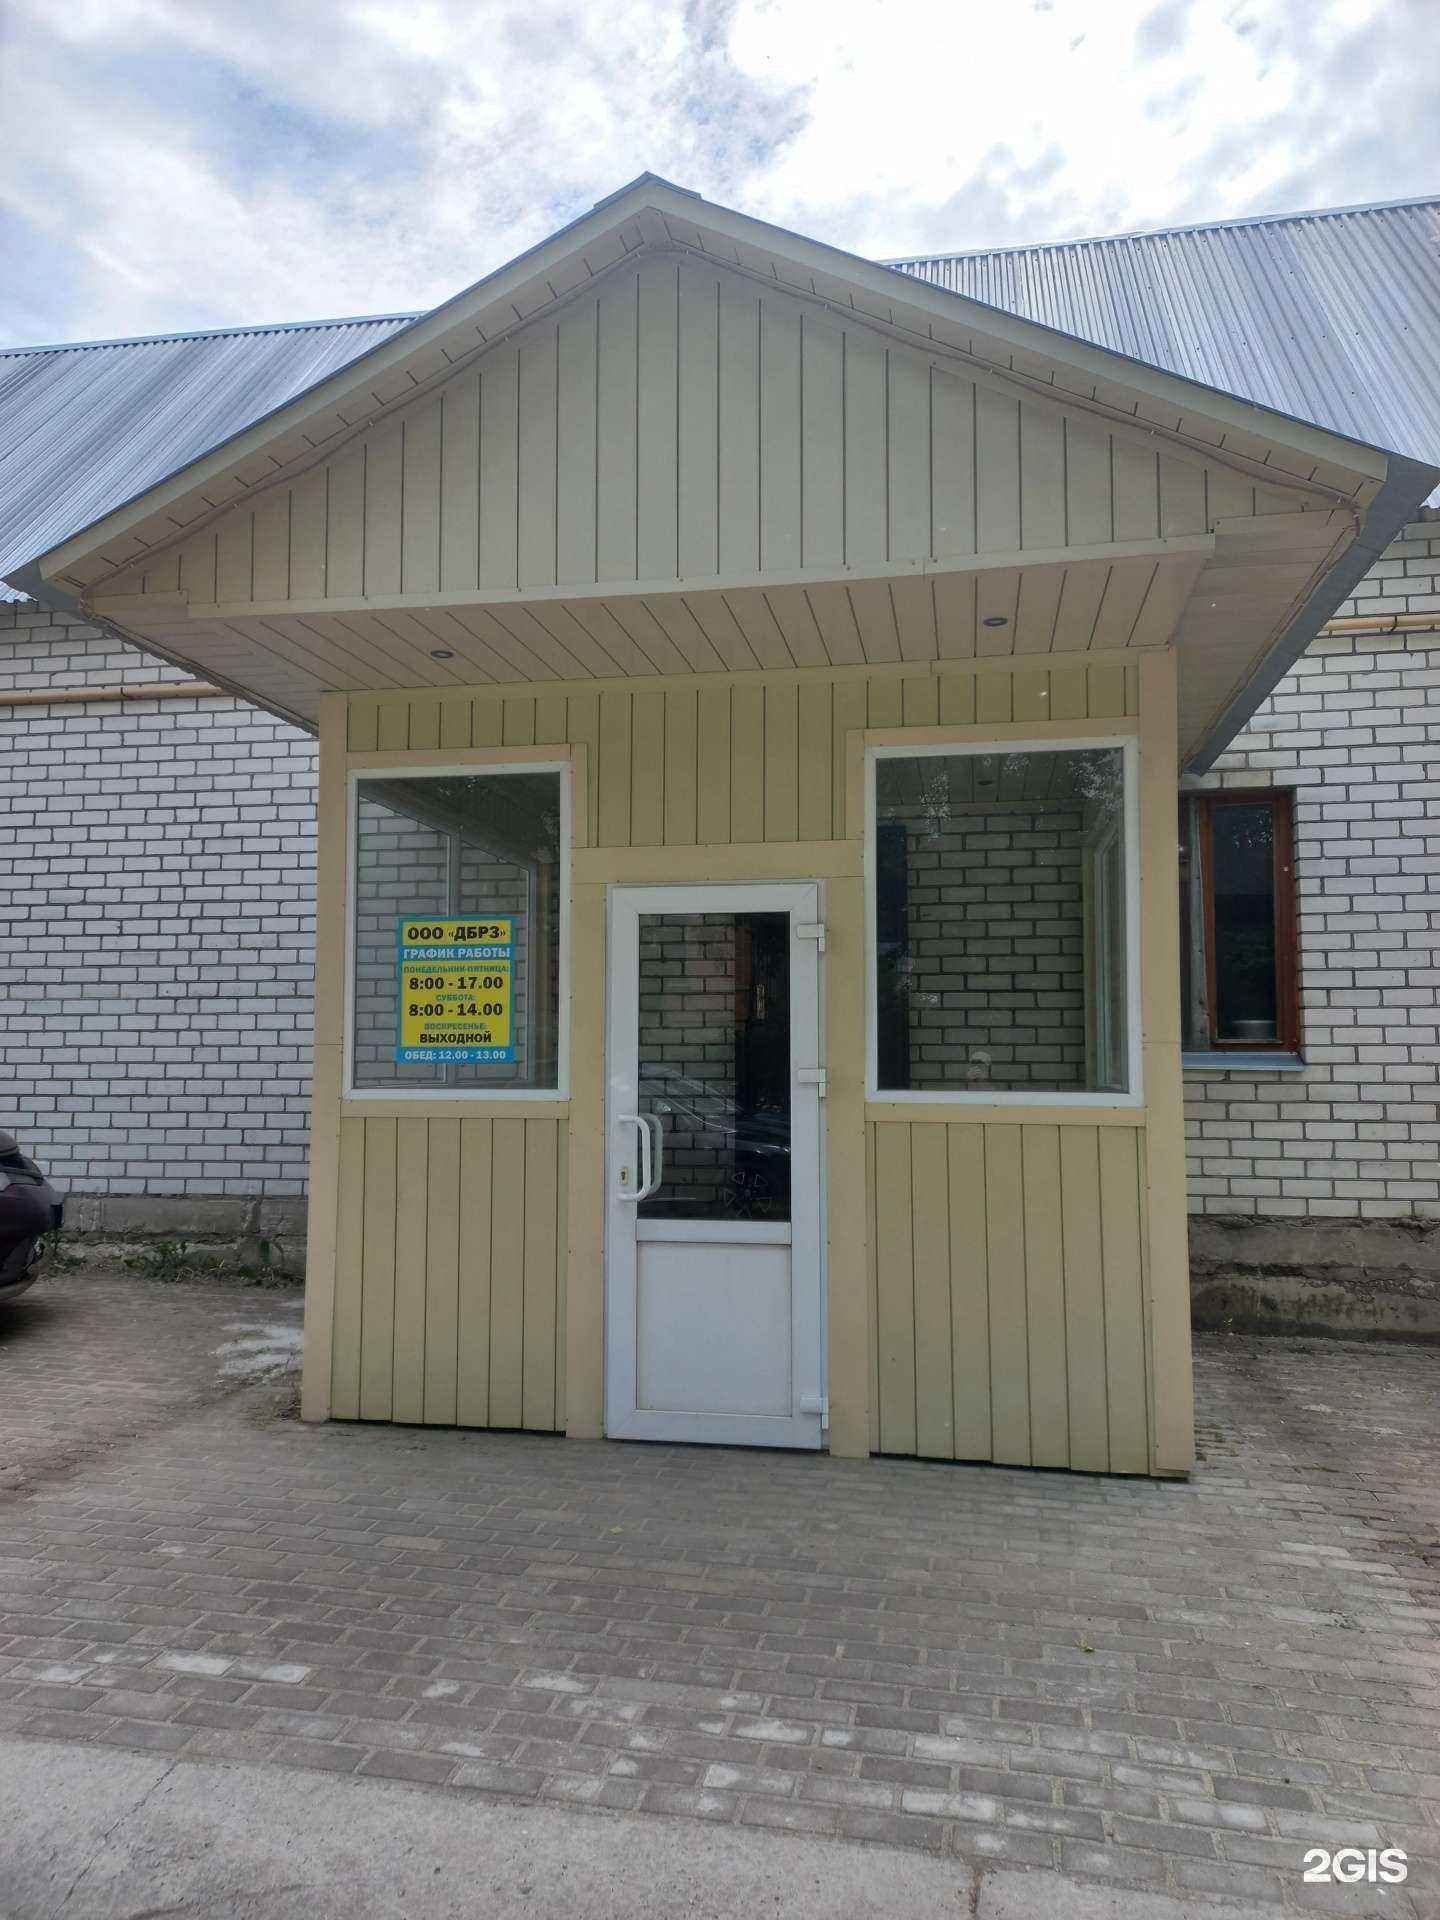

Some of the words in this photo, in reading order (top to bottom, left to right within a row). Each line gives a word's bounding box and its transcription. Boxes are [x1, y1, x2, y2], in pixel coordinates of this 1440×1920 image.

[408, 927, 444, 940] ООО
[448, 926, 506, 941] «ДБРЗ»
[403, 948, 455, 960] ГРАФИК
[458, 947, 510, 959] РАБОТЫ
[409, 977, 444, 990] 8:00
[457, 976, 504, 990] 17.00
[409, 1004, 444, 1017] 8:00
[457, 1003, 503, 1016] 14.00
[419, 1031, 492, 1044] ВЫХОДНОЙ
[404, 1050, 437, 1060] ОБЕД:
[476, 1050, 506, 1060] 13.00
